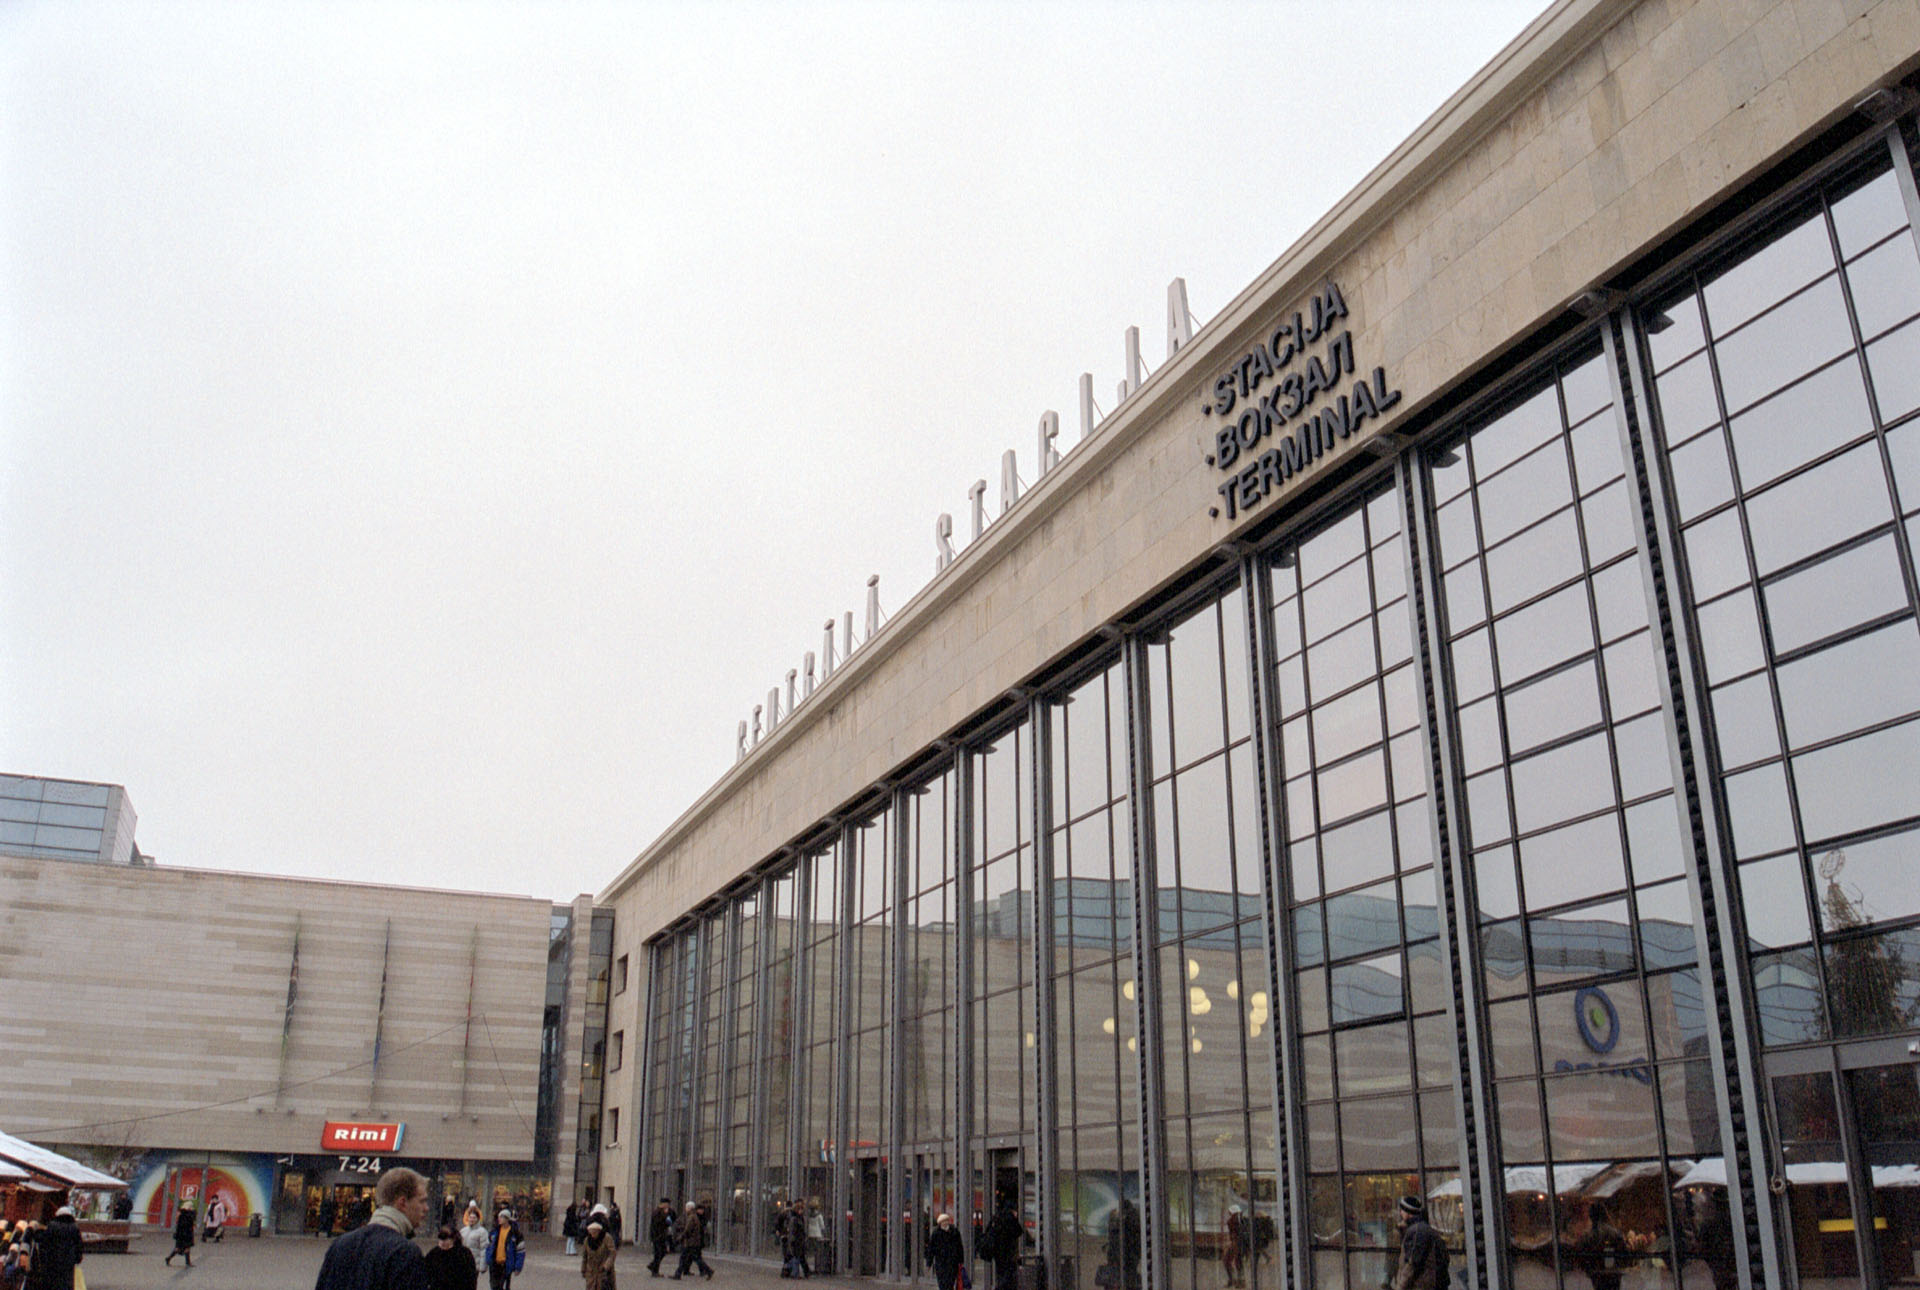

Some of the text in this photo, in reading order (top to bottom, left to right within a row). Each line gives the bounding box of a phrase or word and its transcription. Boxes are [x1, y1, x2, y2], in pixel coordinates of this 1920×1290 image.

[1213, 278, 1348, 415] STACIJA
[1216, 330, 1355, 470] ВОКЗАЛ
[935, 277, 1192, 578] STACIJA
[1218, 366, 1402, 520] TERMINAL
[339, 1156, 381, 1173] 7-24
